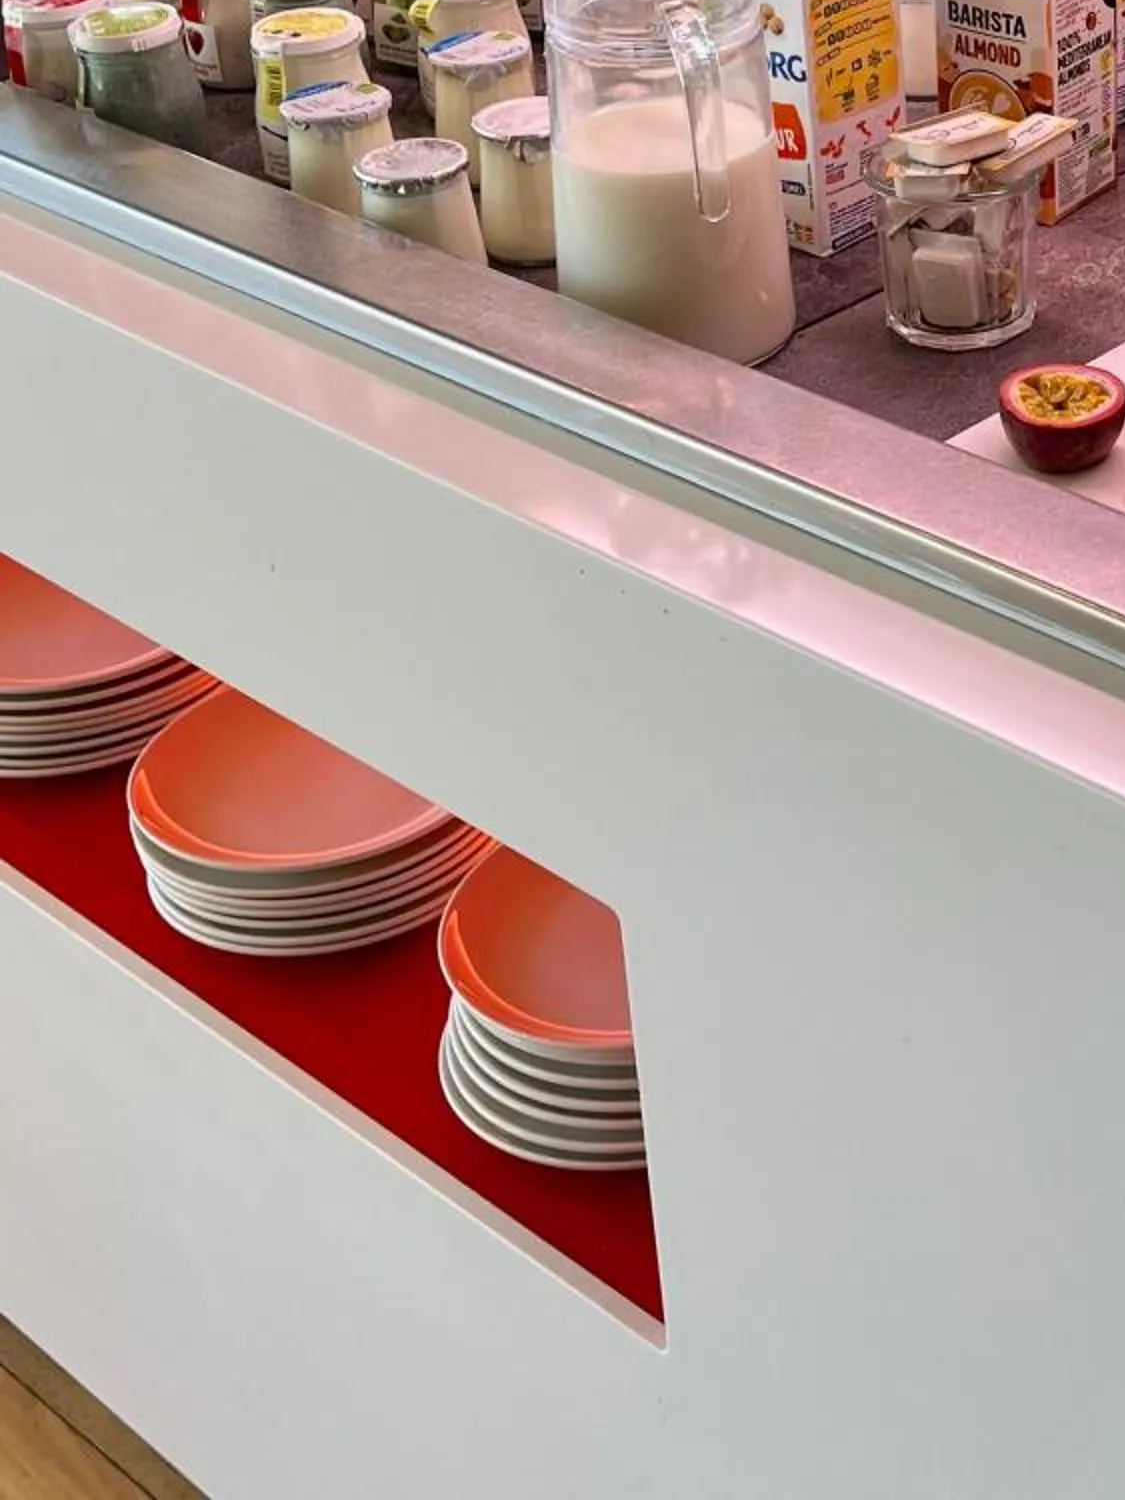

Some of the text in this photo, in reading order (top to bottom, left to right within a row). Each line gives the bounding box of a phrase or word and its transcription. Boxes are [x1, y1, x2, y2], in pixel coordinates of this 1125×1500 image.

[947, 0, 1027, 39] BARISTA
[767, 51, 807, 83] RG
[954, 33, 1021, 68] ALMOND
